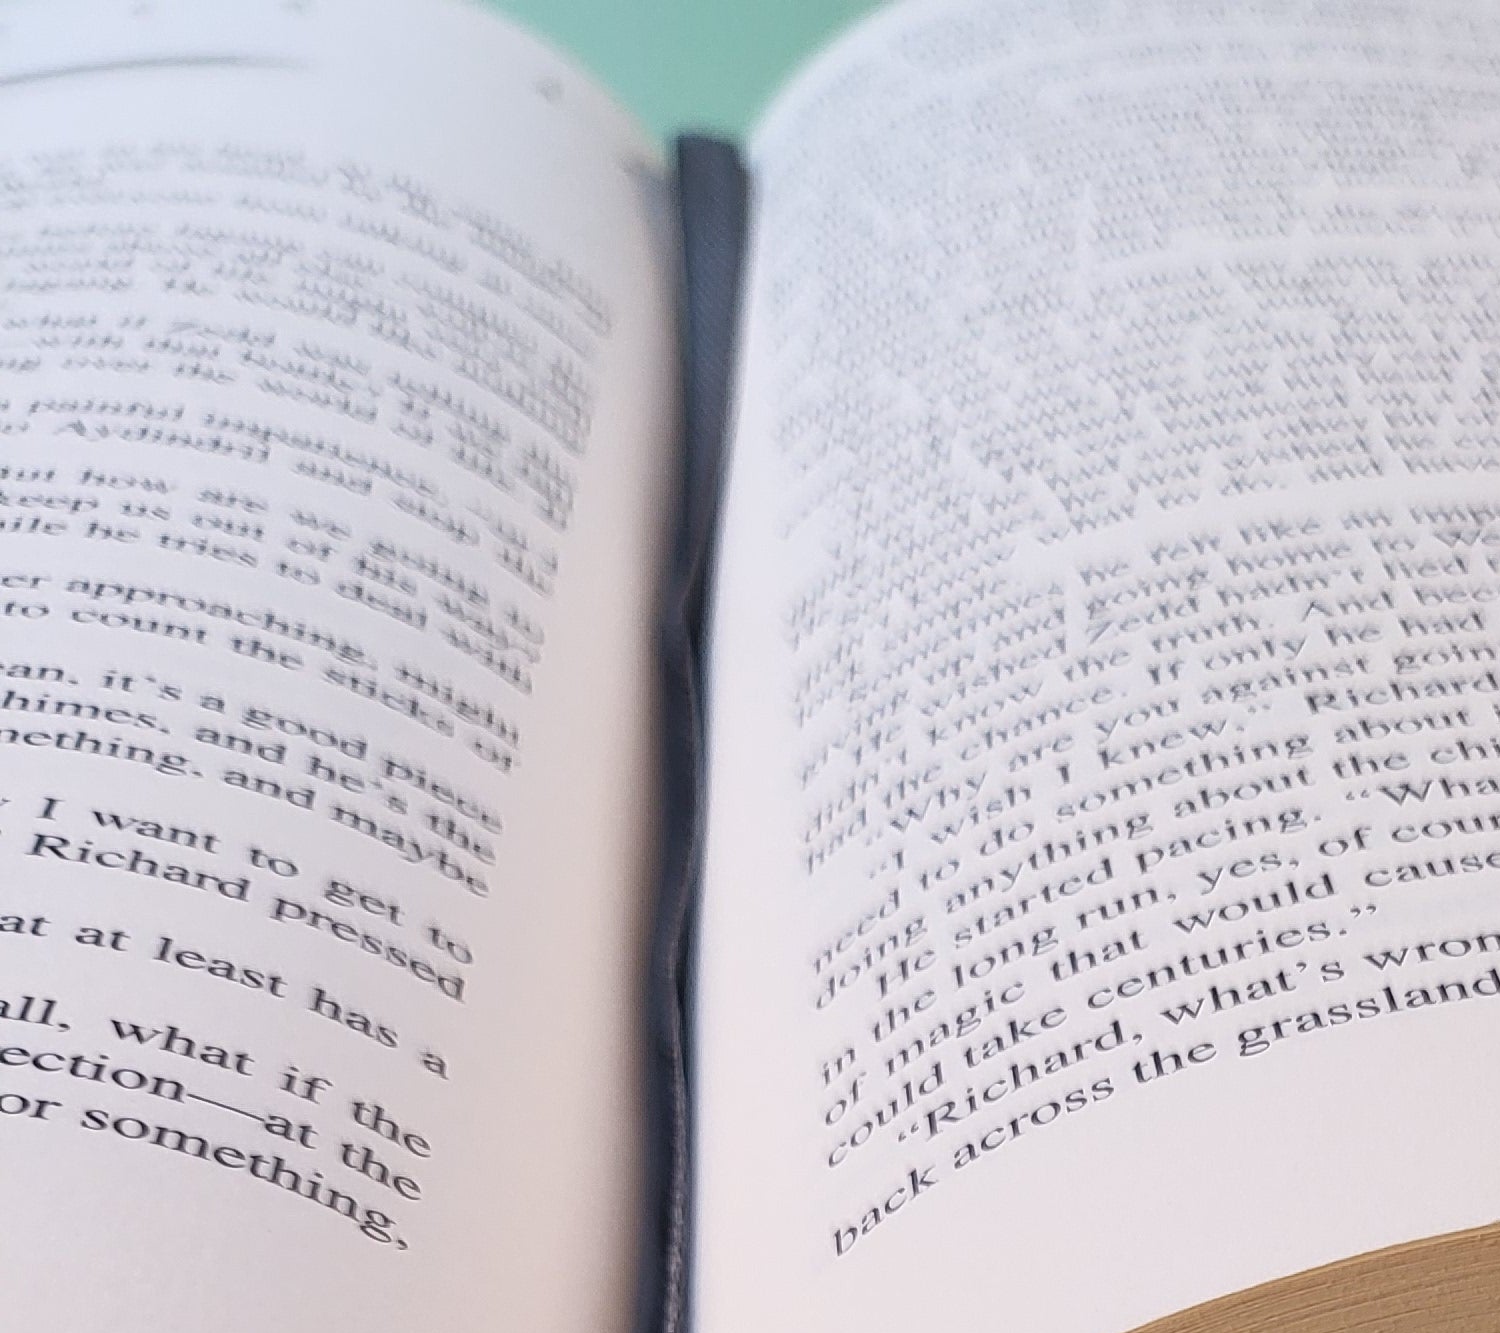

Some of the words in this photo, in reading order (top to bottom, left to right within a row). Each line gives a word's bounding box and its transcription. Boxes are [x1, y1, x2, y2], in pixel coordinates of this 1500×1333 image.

[3, 600, 51, 618] to
[70, 609, 208, 644] count
[230, 636, 304, 670] the
[103, 674, 182, 702] it’s
[199, 694, 226, 714] a
[241, 706, 369, 761] good
[382, 757, 503, 830] piece
[194, 726, 288, 765] and
[307, 754, 408, 816] he’s
[425, 812, 496, 863] the
[222, 769, 317, 811] and
[331, 804, 489, 897] maybe
[29, 832, 252, 902] Richard
[269, 896, 466, 1002] pressed
[36, 794, 64, 823] I
[91, 809, 217, 854] want
[248, 846, 300, 878] to
[323, 878, 401, 926] get
[427, 925, 474, 965] to
[812, 887, 901, 975] need
[918, 858, 961, 891] to
[978, 821, 1035, 857] do
[1056, 735, 1310, 817] something
[1334, 709, 1469, 744] about
[815, 916, 925, 1011] doing
[945, 812, 1150, 915] anything
[1173, 767, 1309, 819] about
[1331, 753, 1408, 779] the
[876, 948, 935, 998] He
[953, 856, 1114, 943] started
[1134, 807, 1324, 875] pacing.
[73, 926, 129, 952] at
[154, 935, 284, 999] least
[308, 986, 399, 1049] has
[420, 1051, 449, 1081] a
[821, 1046, 857, 1086] in
[871, 988, 936, 1043] the
[952, 926, 1055, 989] long
[1075, 886, 1177, 930] run,
[1196, 852, 1300, 891] yes,
[1317, 826, 1366, 856] of
[823, 1078, 860, 1126] of
[885, 981, 1024, 1077] magic
[1049, 929, 1142, 982] that
[1172, 871, 1336, 934] would
[826, 1060, 944, 1169] could
[962, 1006, 1065, 1069] take
[1086, 903, 1378, 1010] centuries.”
[109, 1018, 252, 1077] what
[279, 1065, 334, 1103] if
[351, 1100, 432, 1159] the
[897, 1018, 1144, 1143] “Richard,
[1159, 960, 1346, 1025] what’s
[79, 1108, 409, 1252] something,
[340, 1141, 422, 1202] the
[832, 1167, 936, 1258] back
[953, 1076, 1116, 1170] across
[1131, 1041, 1217, 1084] the
